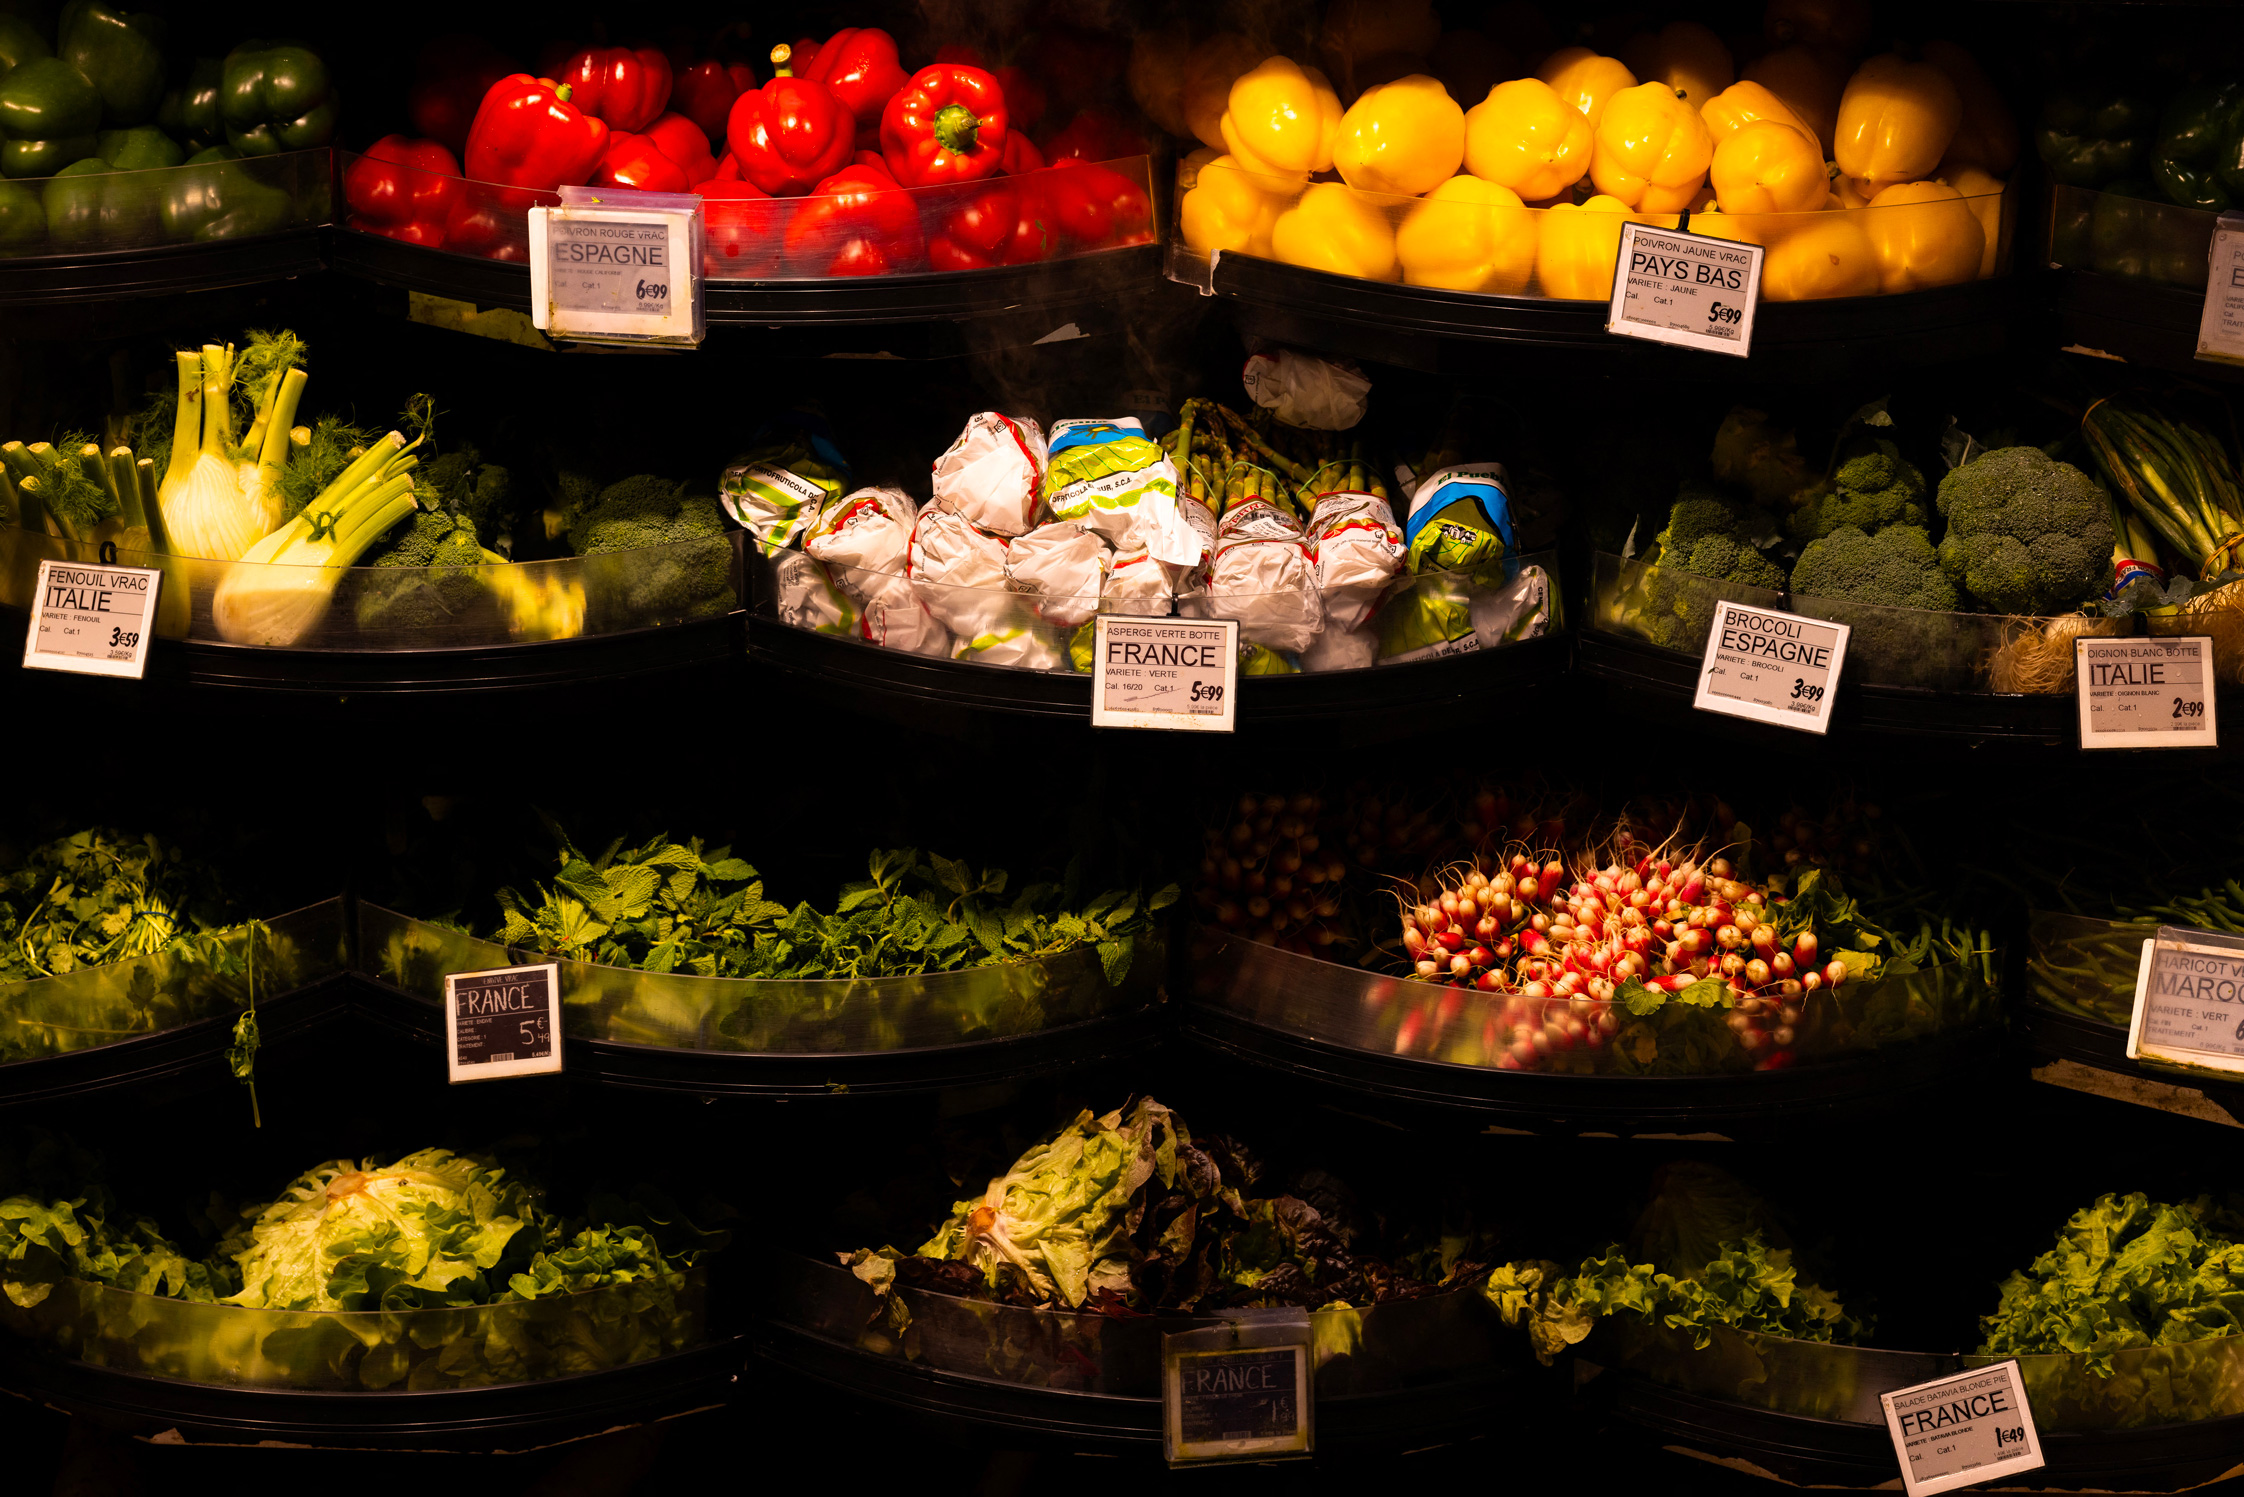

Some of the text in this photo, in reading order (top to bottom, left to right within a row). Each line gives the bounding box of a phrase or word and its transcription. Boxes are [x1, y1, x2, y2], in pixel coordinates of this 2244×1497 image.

[552, 226, 665, 240] POIVRON ROUGE VRAC
[555, 242, 663, 265] ESPAGNE
[1633, 236, 1748, 265] POIVRON JAUNE VRAC
[1631, 252, 1742, 289] PAYS BAS
[636, 279, 668, 300] 6€99
[1625, 291, 1640, 300] Cal.
[1627, 277, 1663, 290] VARIETE
[1670, 284, 1698, 297] JAUNE
[1707, 301, 1742, 325] 5€99
[48, 569, 148, 591] FENOUIL VRAC
[45, 587, 113, 612] ITALIE
[41, 611, 68, 620] VARIETE
[73, 614, 101, 624] FENOUIL
[1725, 610, 1802, 639] BROCOLI
[109, 626, 140, 648] 3€59
[1107, 627, 1220, 640] ASPERGE VERTE BOTTE
[1108, 642, 1216, 667] FRANCE
[1721, 629, 1830, 668] ESPAGNE
[2087, 647, 2199, 658] OIGNON BLANC BOTTE
[1105, 668, 1142, 677] VARIETE
[1149, 669, 1178, 678] VERTE
[1712, 666, 1727, 676] Cal.
[1716, 653, 1746, 665] VARIETE
[1751, 660, 1784, 673] BROCOLI
[2090, 663, 2166, 686] ITALIE
[1105, 682, 1119, 690] Cal.
[1122, 683, 1143, 691] 16/20
[1190, 680, 1224, 702] 5€99
[1790, 677, 1824, 702] 3€99
[2090, 704, 2105, 712] Cal.
[2172, 697, 2205, 719] 2€99
[2159, 955, 2228, 975] HARICOT
[456, 983, 535, 1016] FRANCE
[2149, 1005, 2193, 1018] VARIETE
[2202, 1010, 2229, 1022] VERT
[1182, 1363, 1278, 1394] FRANCE
[1894, 1374, 2007, 1410] SALADE BATAVIA BLONDE PIE
[1900, 1390, 2009, 1436] FRANCE
[1995, 1426, 2025, 1448] 1€49
